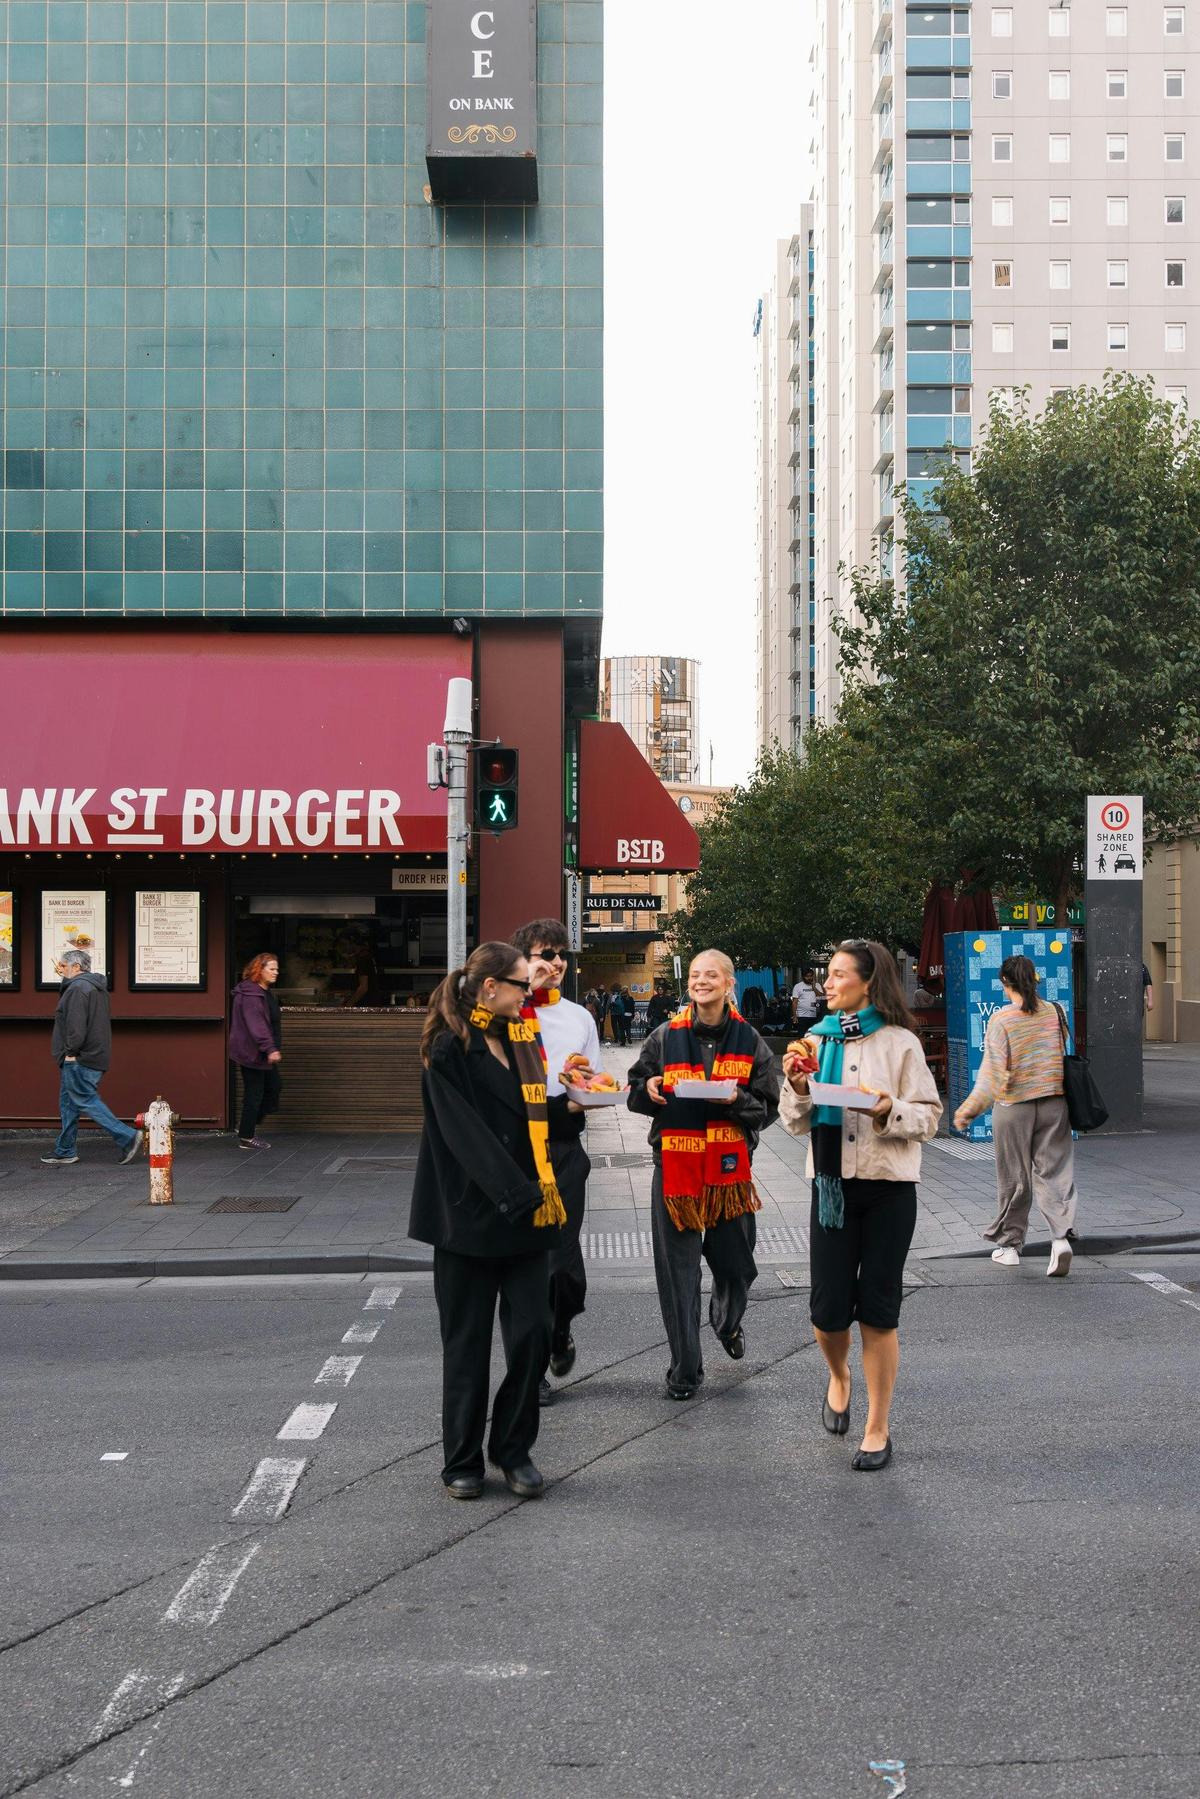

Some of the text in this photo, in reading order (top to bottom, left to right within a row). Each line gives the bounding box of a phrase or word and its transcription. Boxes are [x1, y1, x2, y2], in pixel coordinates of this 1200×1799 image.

[450, 97, 514, 110] ON BANK
[107, 787, 168, 830] ST
[182, 788, 405, 846] BURGER
[1108, 811, 1123, 822] 10
[1097, 833, 1134, 841] SHARED
[617, 839, 665, 863] BSTB
[399, 873, 426, 884] ORDER
[572, 901, 577, 913] ST
[587, 898, 608, 907] RUE
[611, 898, 625, 907] DE
[627, 898, 656, 907] SIAM
[717, 1062, 749, 1076] CROWS
